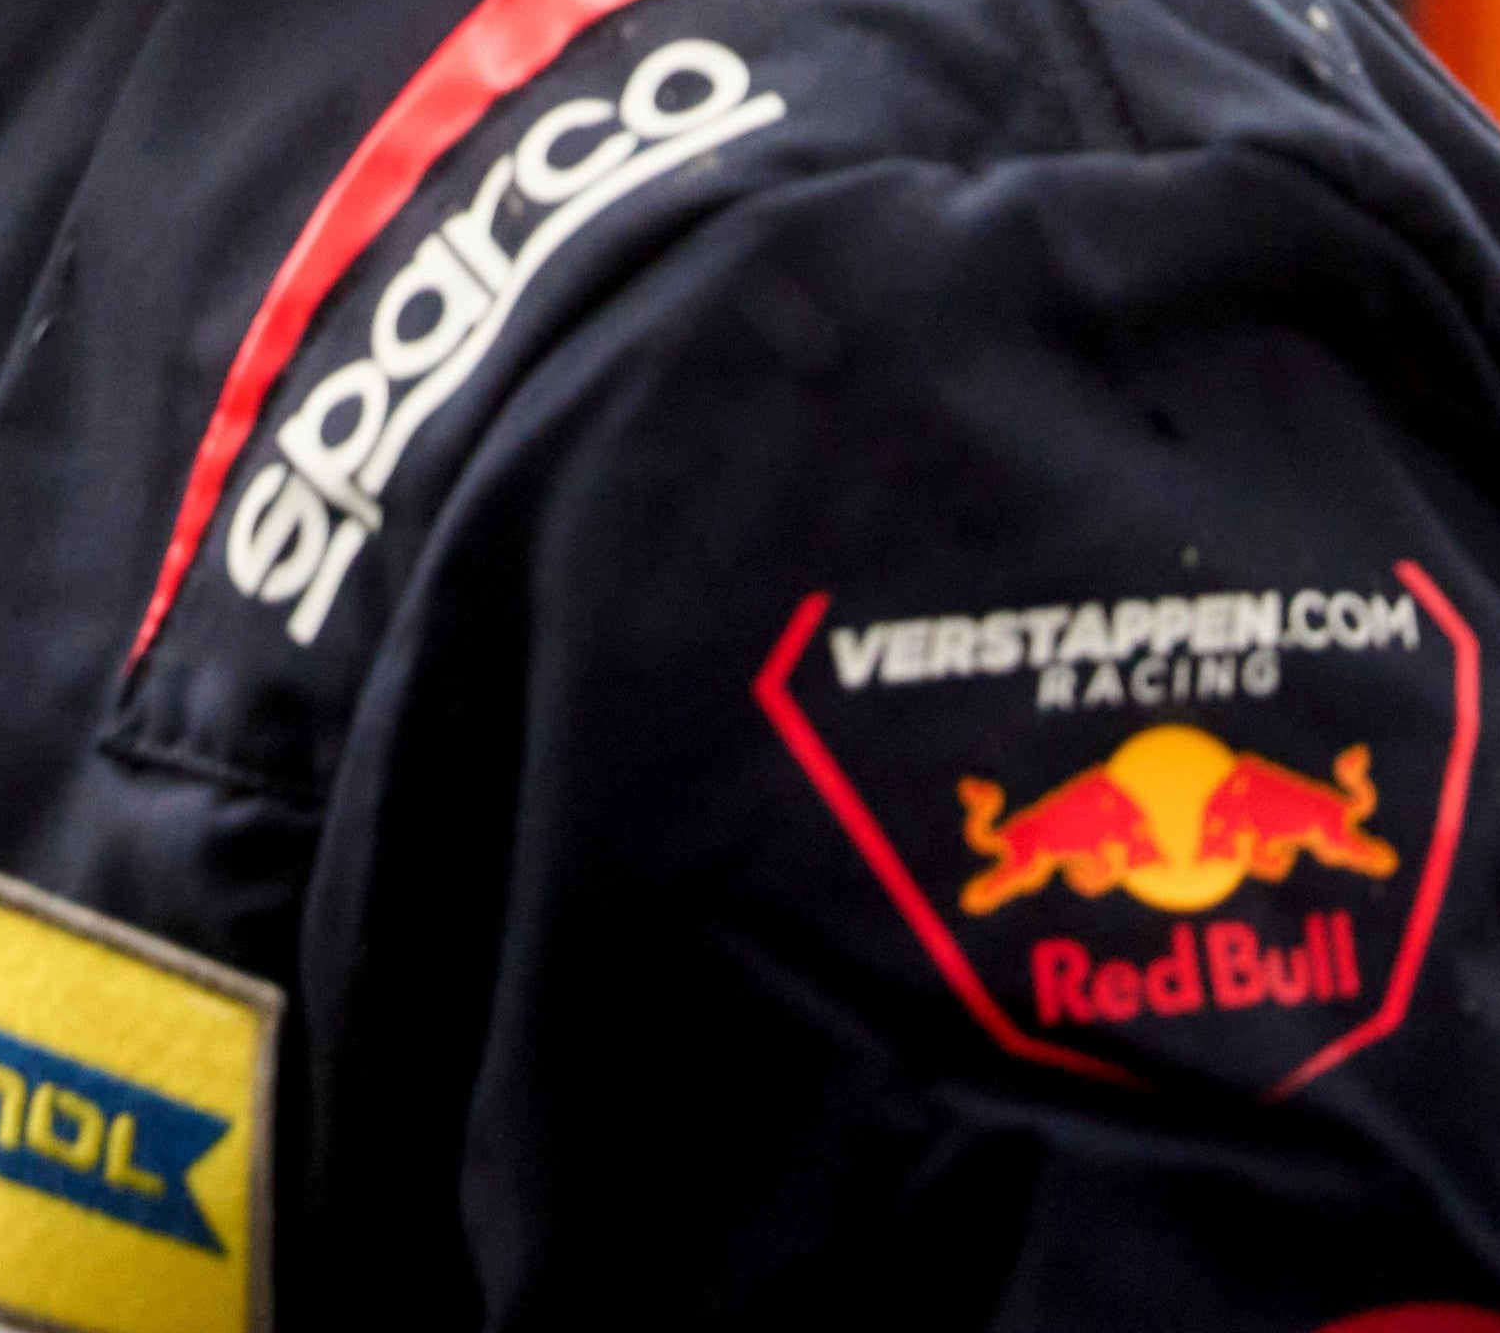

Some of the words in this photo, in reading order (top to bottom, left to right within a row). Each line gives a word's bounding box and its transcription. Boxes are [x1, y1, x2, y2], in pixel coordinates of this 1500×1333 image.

[226, 37, 762, 618] sparco
[829, 588, 1420, 691] VERSTAPPEN.COM
[1036, 651, 1282, 712] RACING
